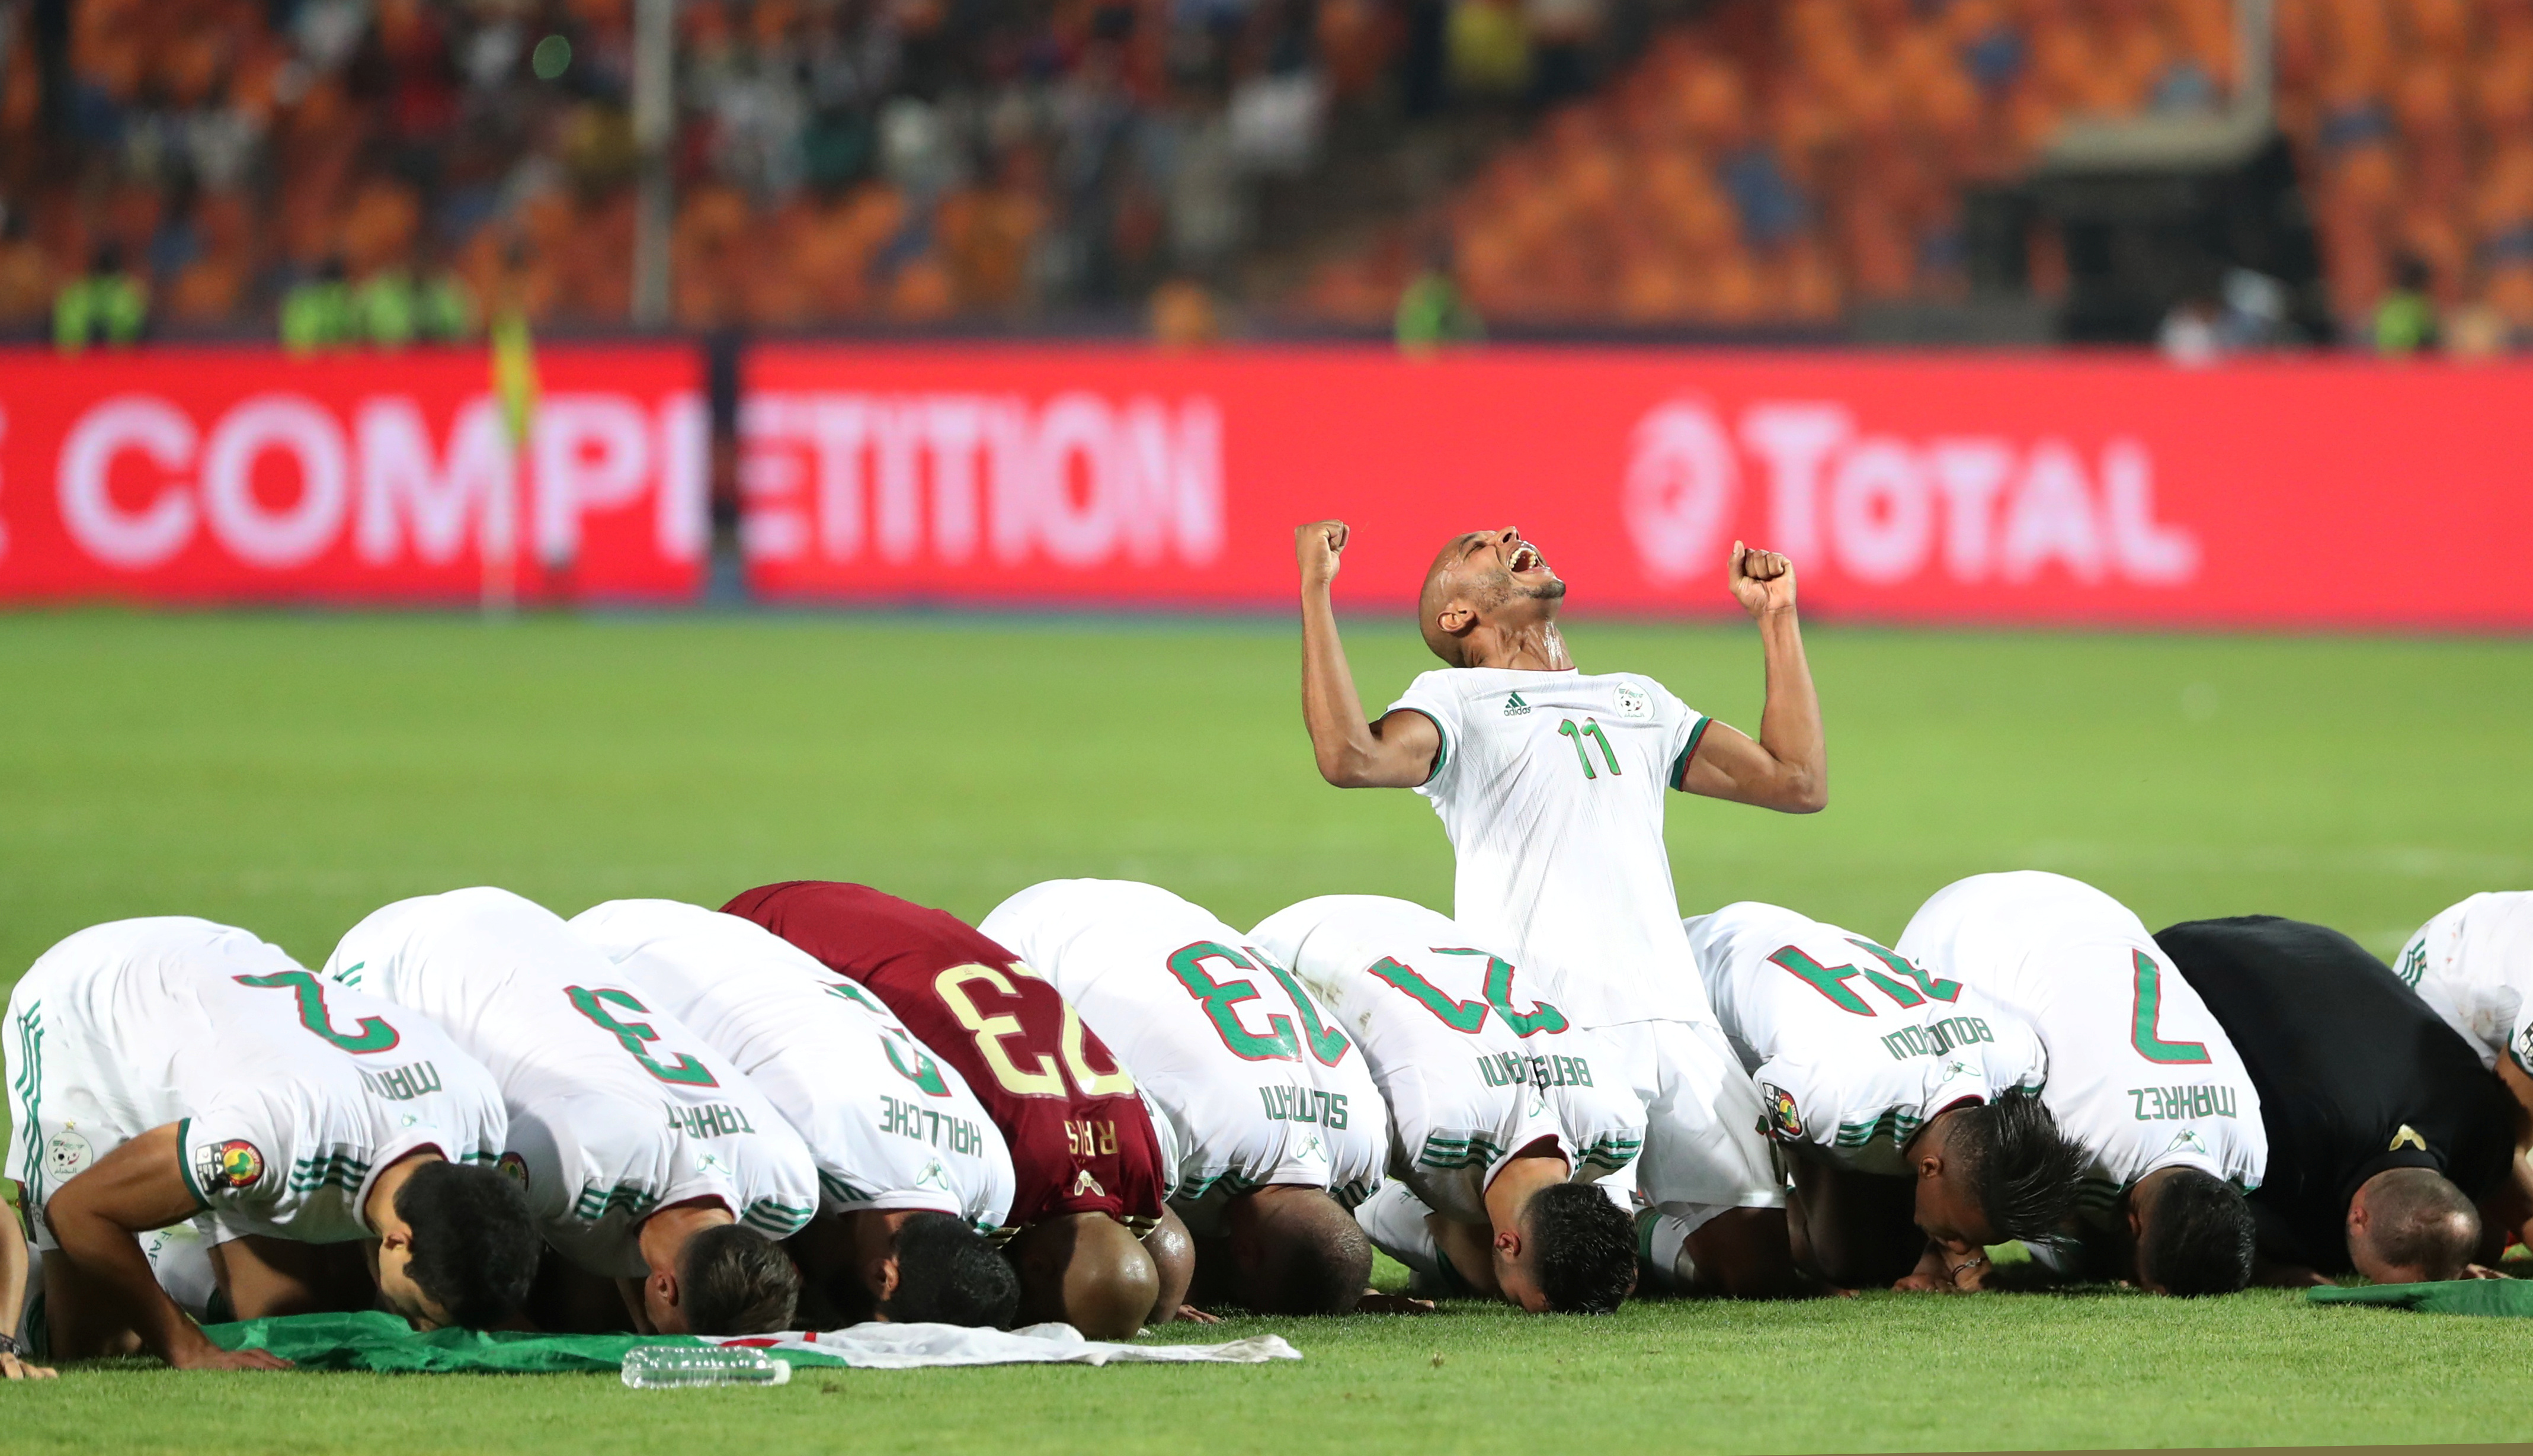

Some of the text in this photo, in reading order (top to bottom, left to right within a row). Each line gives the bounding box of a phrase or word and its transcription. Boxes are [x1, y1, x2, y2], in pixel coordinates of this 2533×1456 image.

[1735, 395, 2199, 586] TOTAL
[1503, 705, 1531, 716] adidas
[1558, 717, 1622, 780] 11
[230, 970, 400, 1055] 2
[1166, 940, 1352, 1068] 13
[1367, 946, 1570, 1039] 21
[1766, 938, 1964, 1017] 14
[2131, 947, 2213, 1064] 7
[562, 984, 721, 1088] 3
[931, 960, 1135, 1103] 23
[2127, 1085, 2237, 1121] MAHREZ
[148, 1230, 173, 1267] FAF
